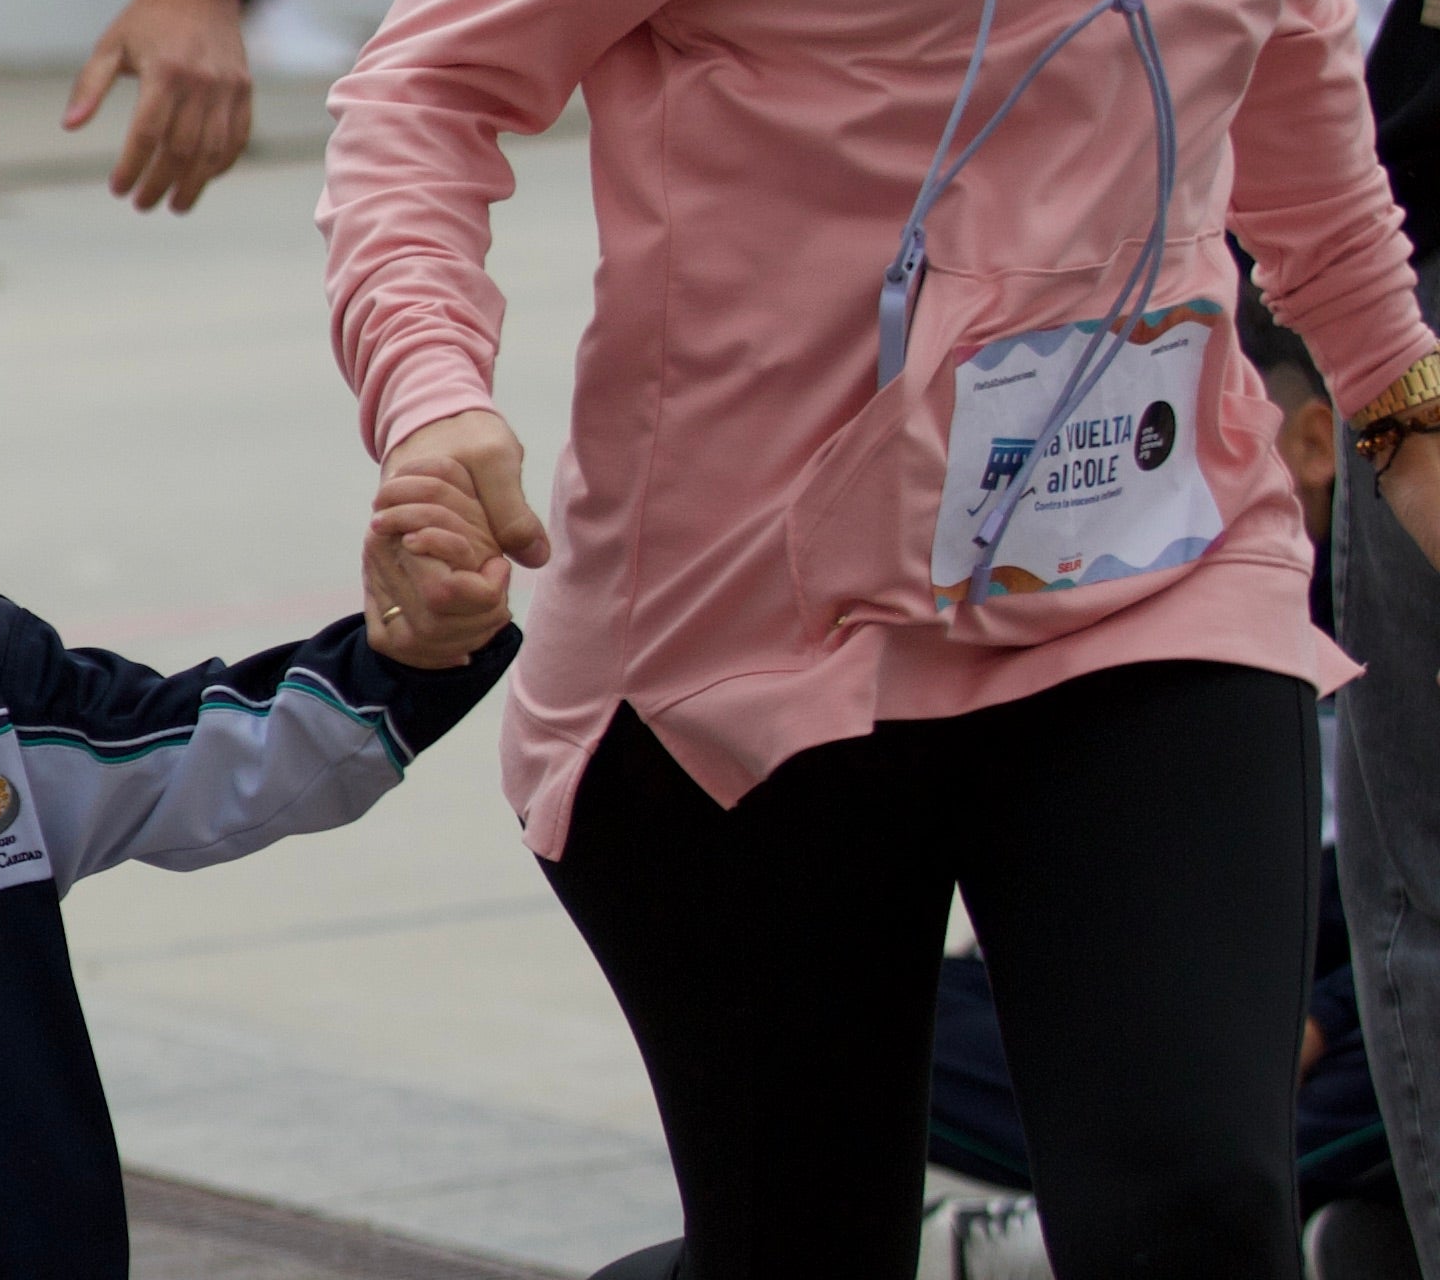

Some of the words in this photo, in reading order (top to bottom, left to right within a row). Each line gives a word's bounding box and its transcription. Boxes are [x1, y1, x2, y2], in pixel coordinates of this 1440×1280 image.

[1066, 414, 1133, 452] VUELTA
[1047, 464, 1067, 494] al
[1071, 455, 1119, 490] COLE
